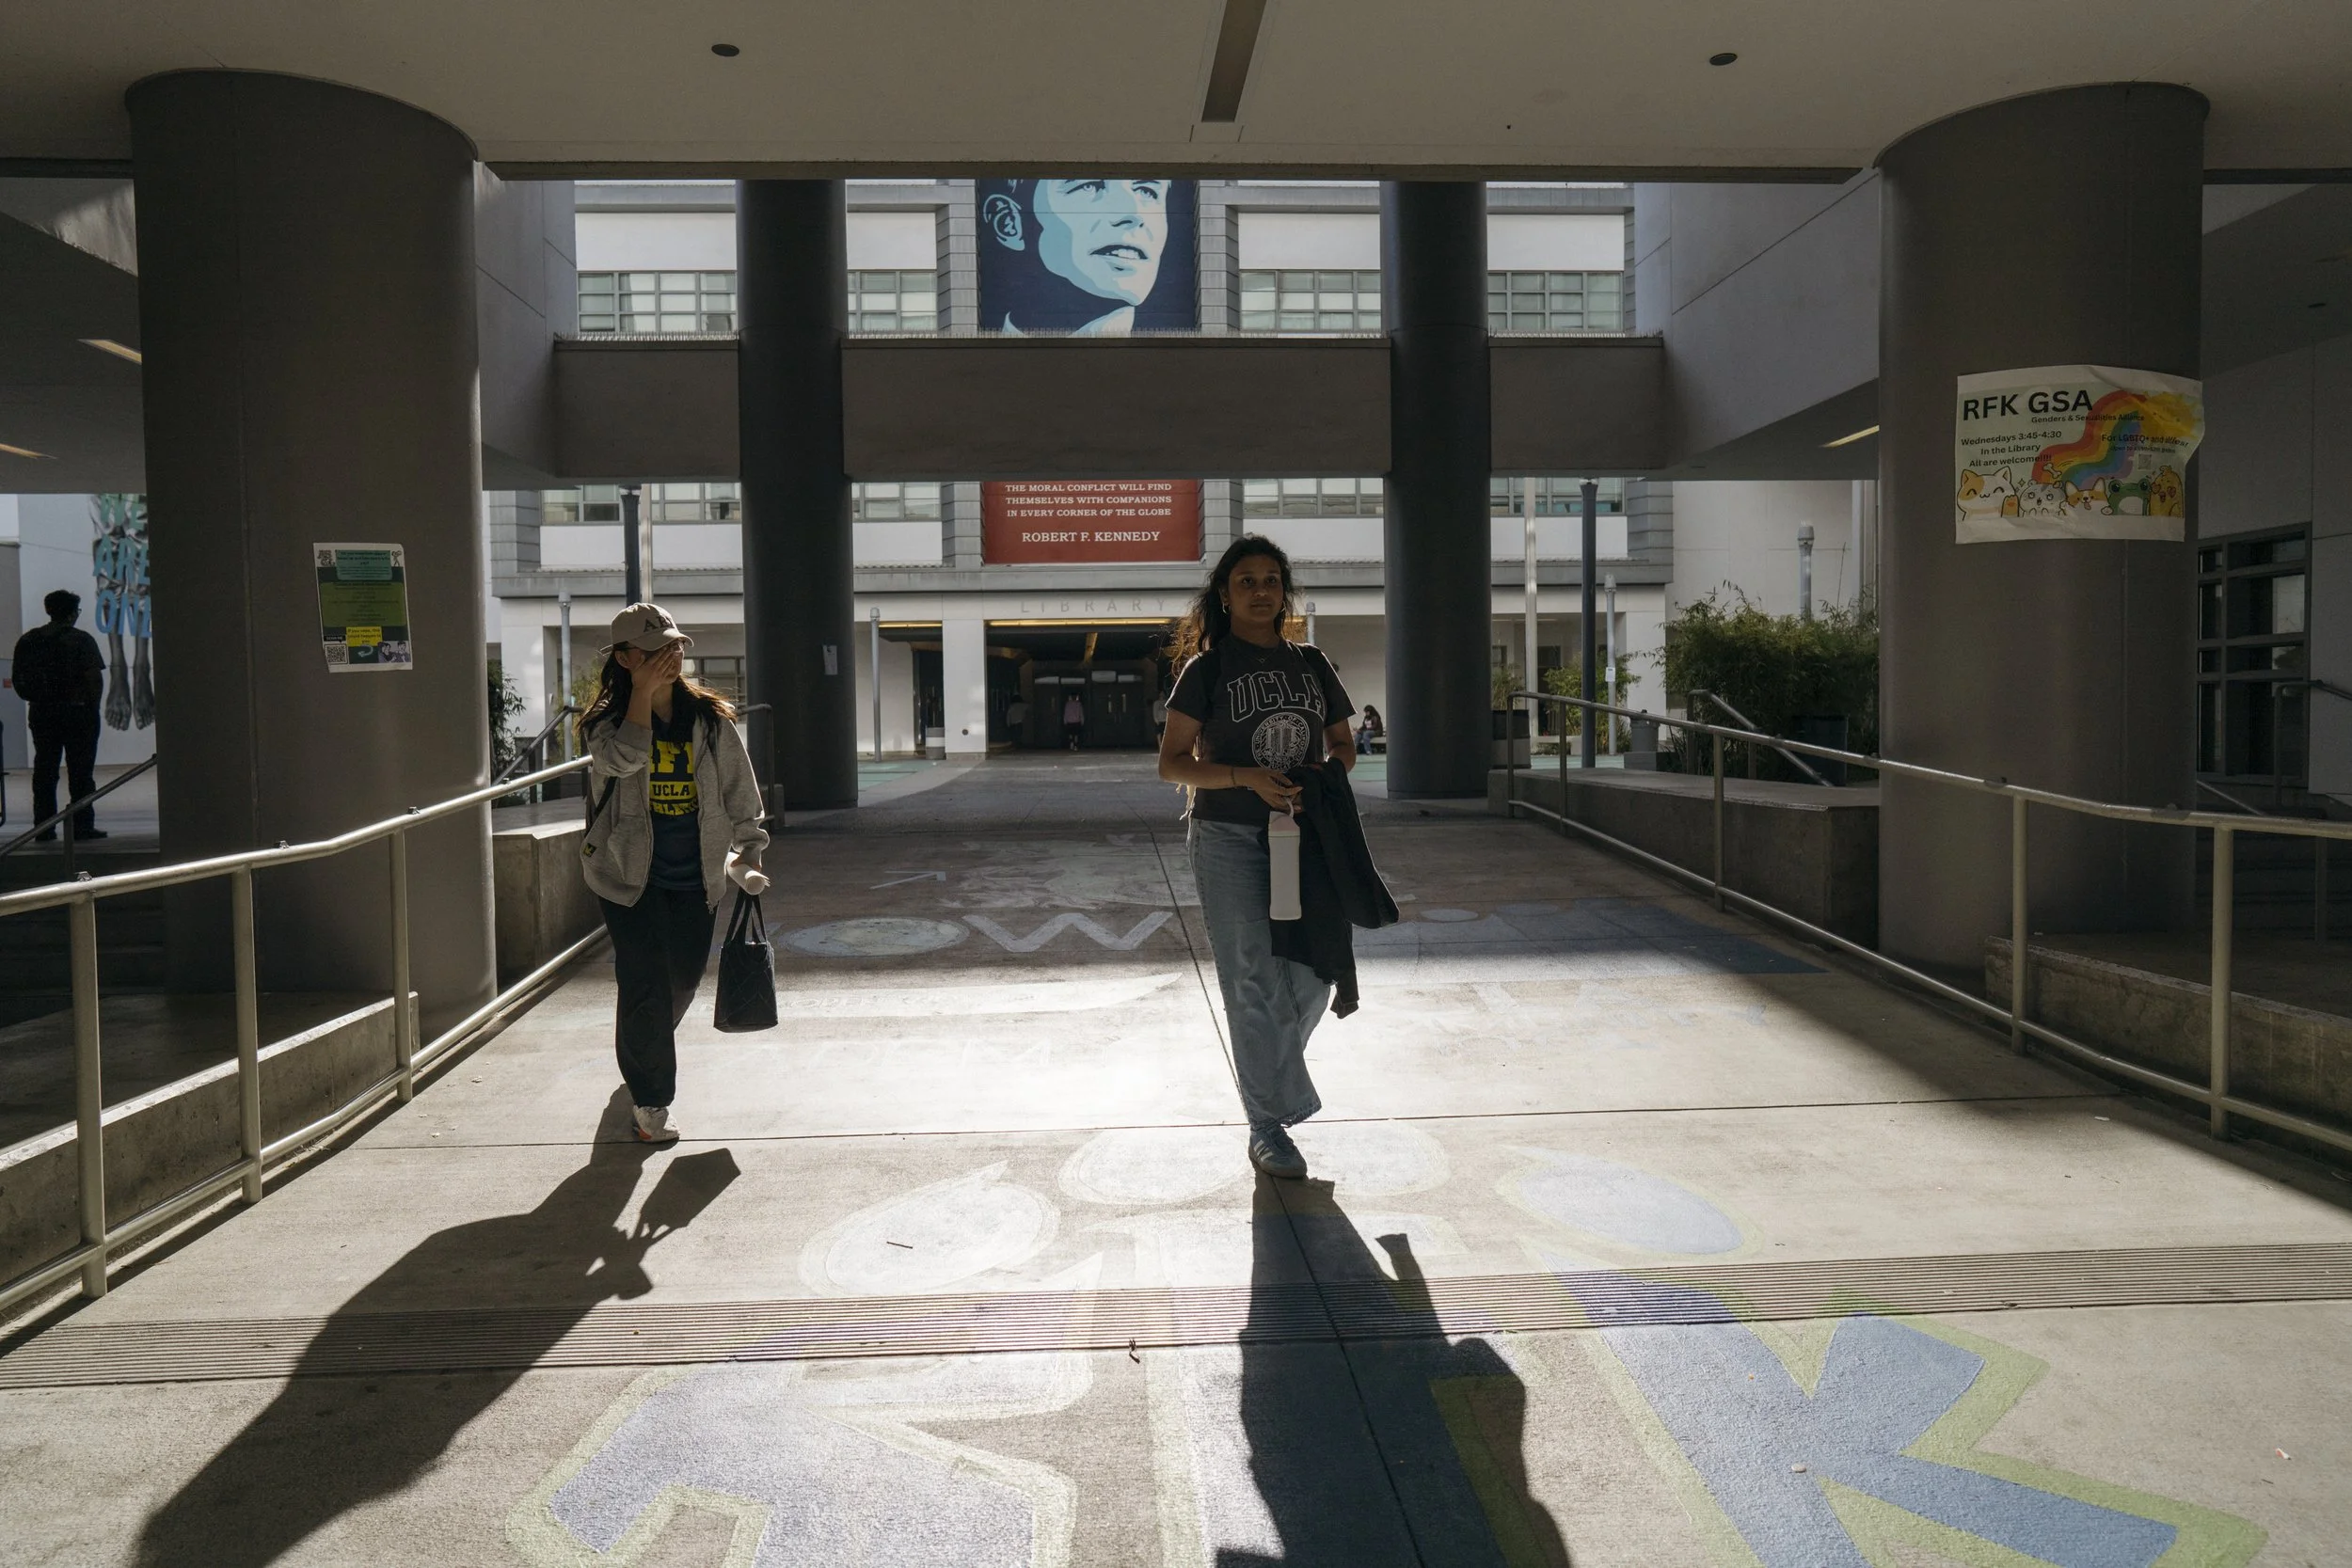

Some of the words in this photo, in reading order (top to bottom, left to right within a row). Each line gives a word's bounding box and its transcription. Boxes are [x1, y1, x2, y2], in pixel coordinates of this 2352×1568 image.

[1963, 393, 2019, 421] RFK
[2028, 389, 2093, 414] GSA
[1961, 435, 2016, 446] Wednesdays
[2018, 431, 2062, 440] 3:45-4:30
[2102, 434, 2116, 442] For
[2008, 444, 2041, 453] Library
[1969, 459, 1981, 467] All
[1022, 531, 1077, 543] ROBERT
[1080, 532, 1090, 542] F.
[1094, 531, 1161, 542] KENNEDY
[1020, 598, 1166, 613] LIBRARY
[1227, 671, 1326, 723] UCLA
[652, 784, 690, 796] UCLA
